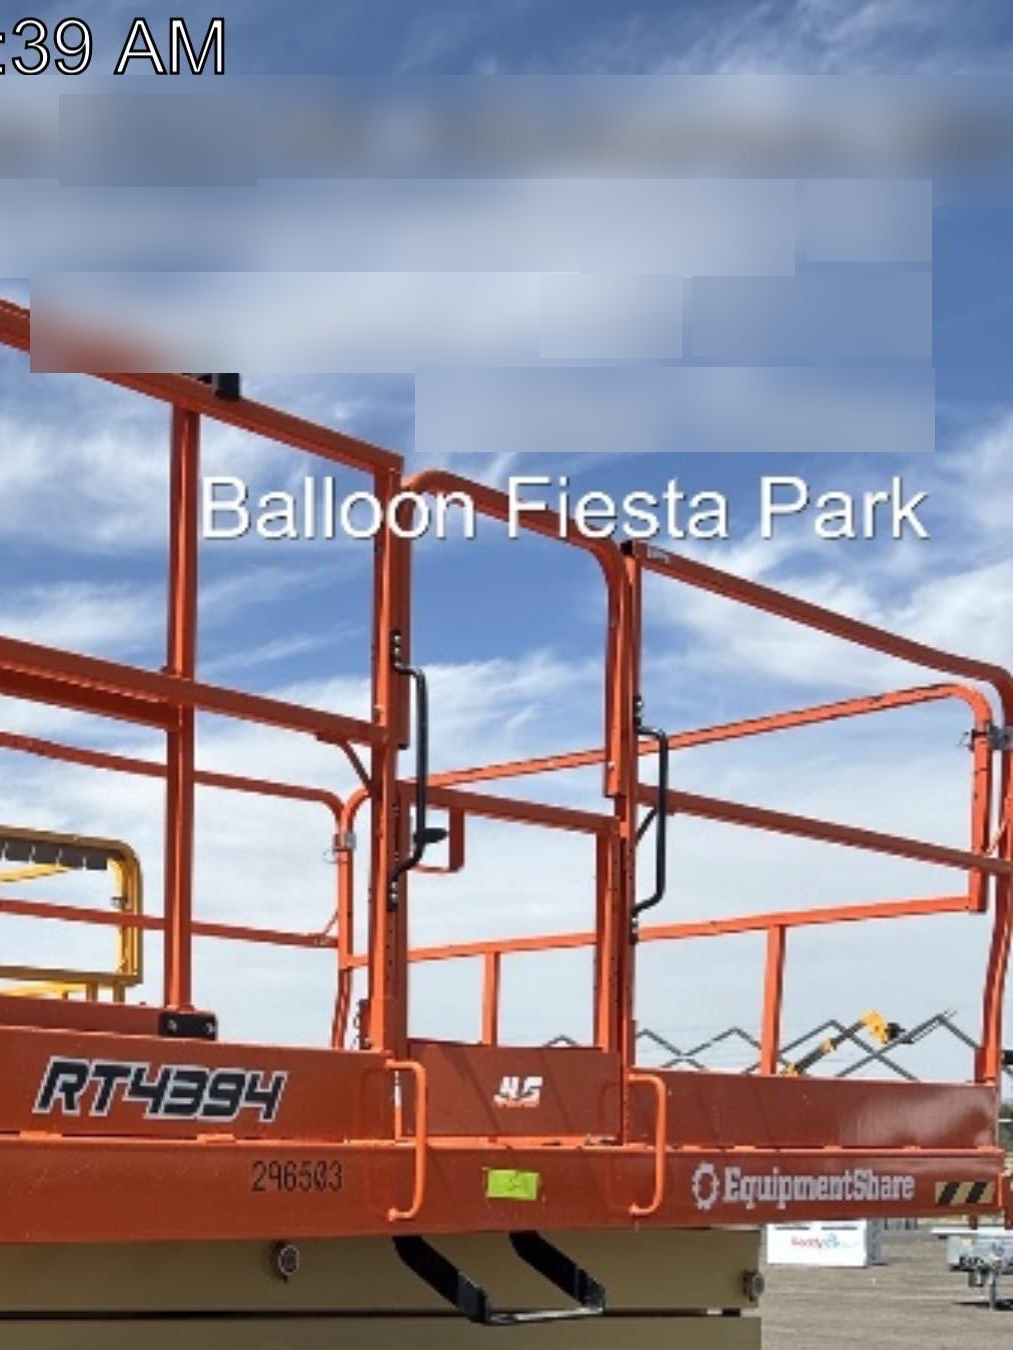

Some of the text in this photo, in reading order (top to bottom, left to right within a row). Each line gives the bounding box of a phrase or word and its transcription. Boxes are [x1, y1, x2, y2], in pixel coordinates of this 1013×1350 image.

[32, 1056, 288, 1122] RT4394
[251, 1161, 342, 1192] 296503
[723, 1166, 915, 1209] EquipmentShare
